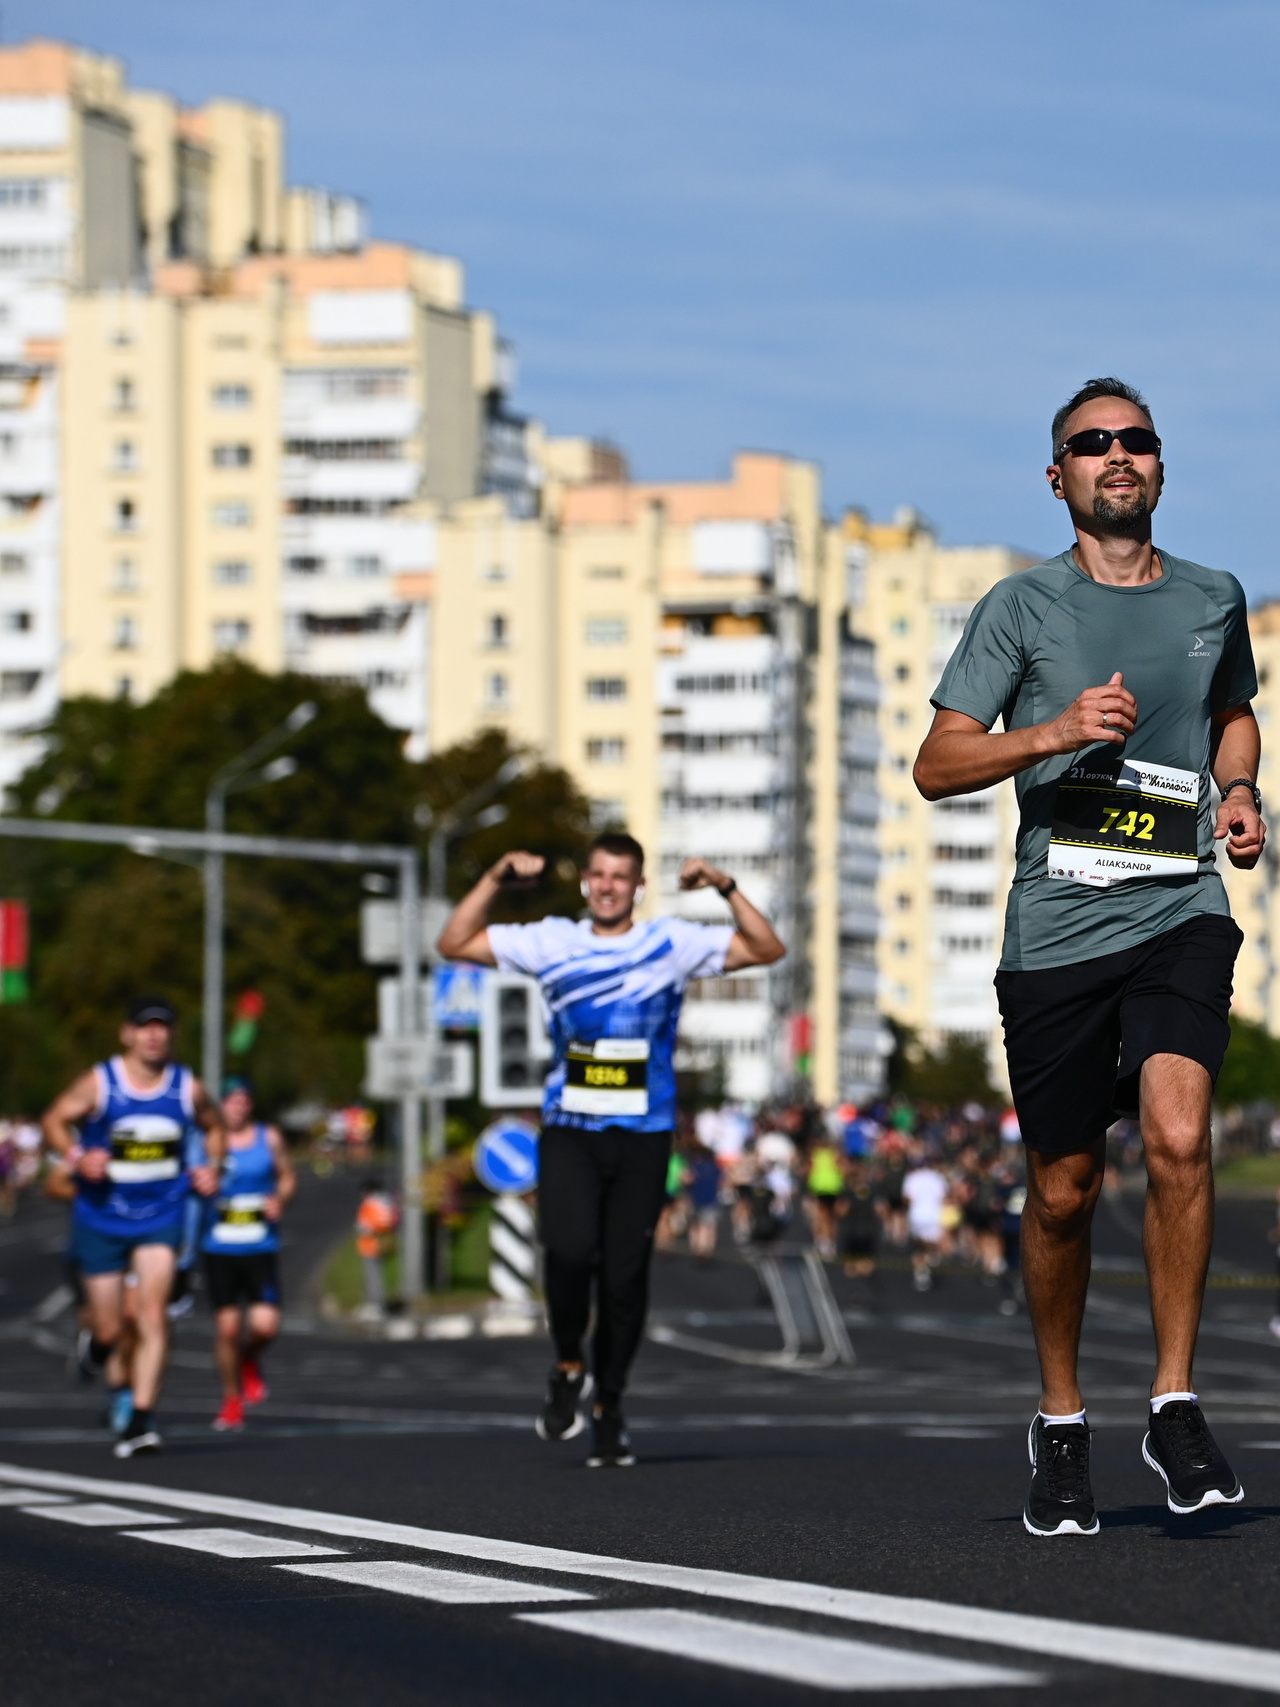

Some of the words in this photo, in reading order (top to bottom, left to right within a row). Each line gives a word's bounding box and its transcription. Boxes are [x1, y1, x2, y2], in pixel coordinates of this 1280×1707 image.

[1150, 780, 1193, 794] МАРАФОН
[1098, 807, 1156, 840] 742
[1095, 858, 1152, 872] ALIAKSANDR
